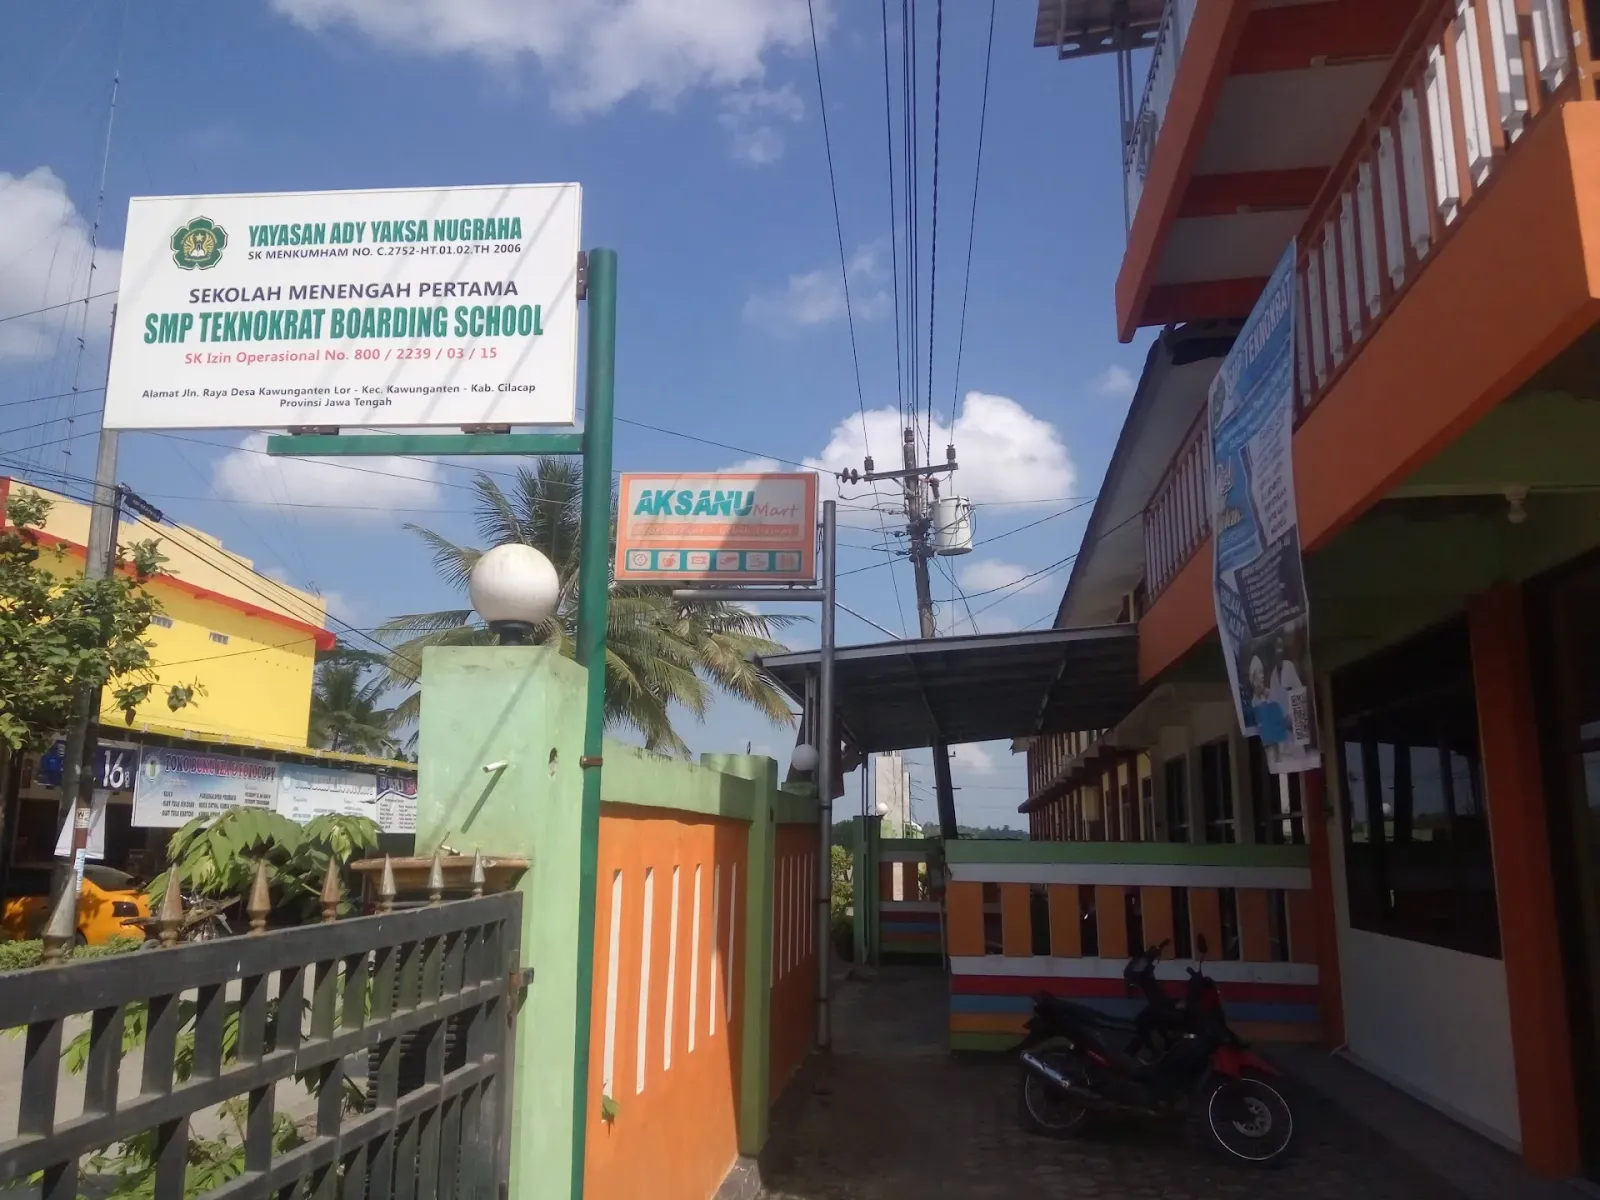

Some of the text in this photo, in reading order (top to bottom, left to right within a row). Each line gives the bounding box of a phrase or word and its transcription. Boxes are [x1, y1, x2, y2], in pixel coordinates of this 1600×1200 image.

[249, 217, 522, 247] YAYASAN ADY YAKSA NUGRAHA
[248, 243, 522, 260] SK MENKUMHAM NO. C.2752-HT.01.02.TH 2006
[189, 280, 518, 304] SEKOLAH MENENGAH PERTAMA
[143, 304, 543, 345] SMP TEKNOKRAT BOARDING SCHOOL
[1243, 272, 1291, 367] TEKNOKRAT
[185, 348, 496, 365] SK Izin Operasional No. 800 / 2239 / 03 / 15
[182, 389, 199, 397] Jln.
[203, 389, 227, 399] Raya
[231, 388, 255, 396] Desa
[258, 387, 331, 397] Kawunganten
[361, 386, 383, 394] Kec.
[386, 384, 460, 396] Kawunganten
[472, 384, 494, 393] Kab.
[498, 383, 535, 393] Cilacap
[280, 398, 321, 407] Provinsi
[355, 398, 392, 408] Tengah
[633, 489, 799, 517] AKSANU Mart
[103, 750, 124, 789] 16
[165, 753, 190, 773] TOKO
[191, 756, 214, 775] BUKU
[239, 761, 277, 781] FOTOCOPY
